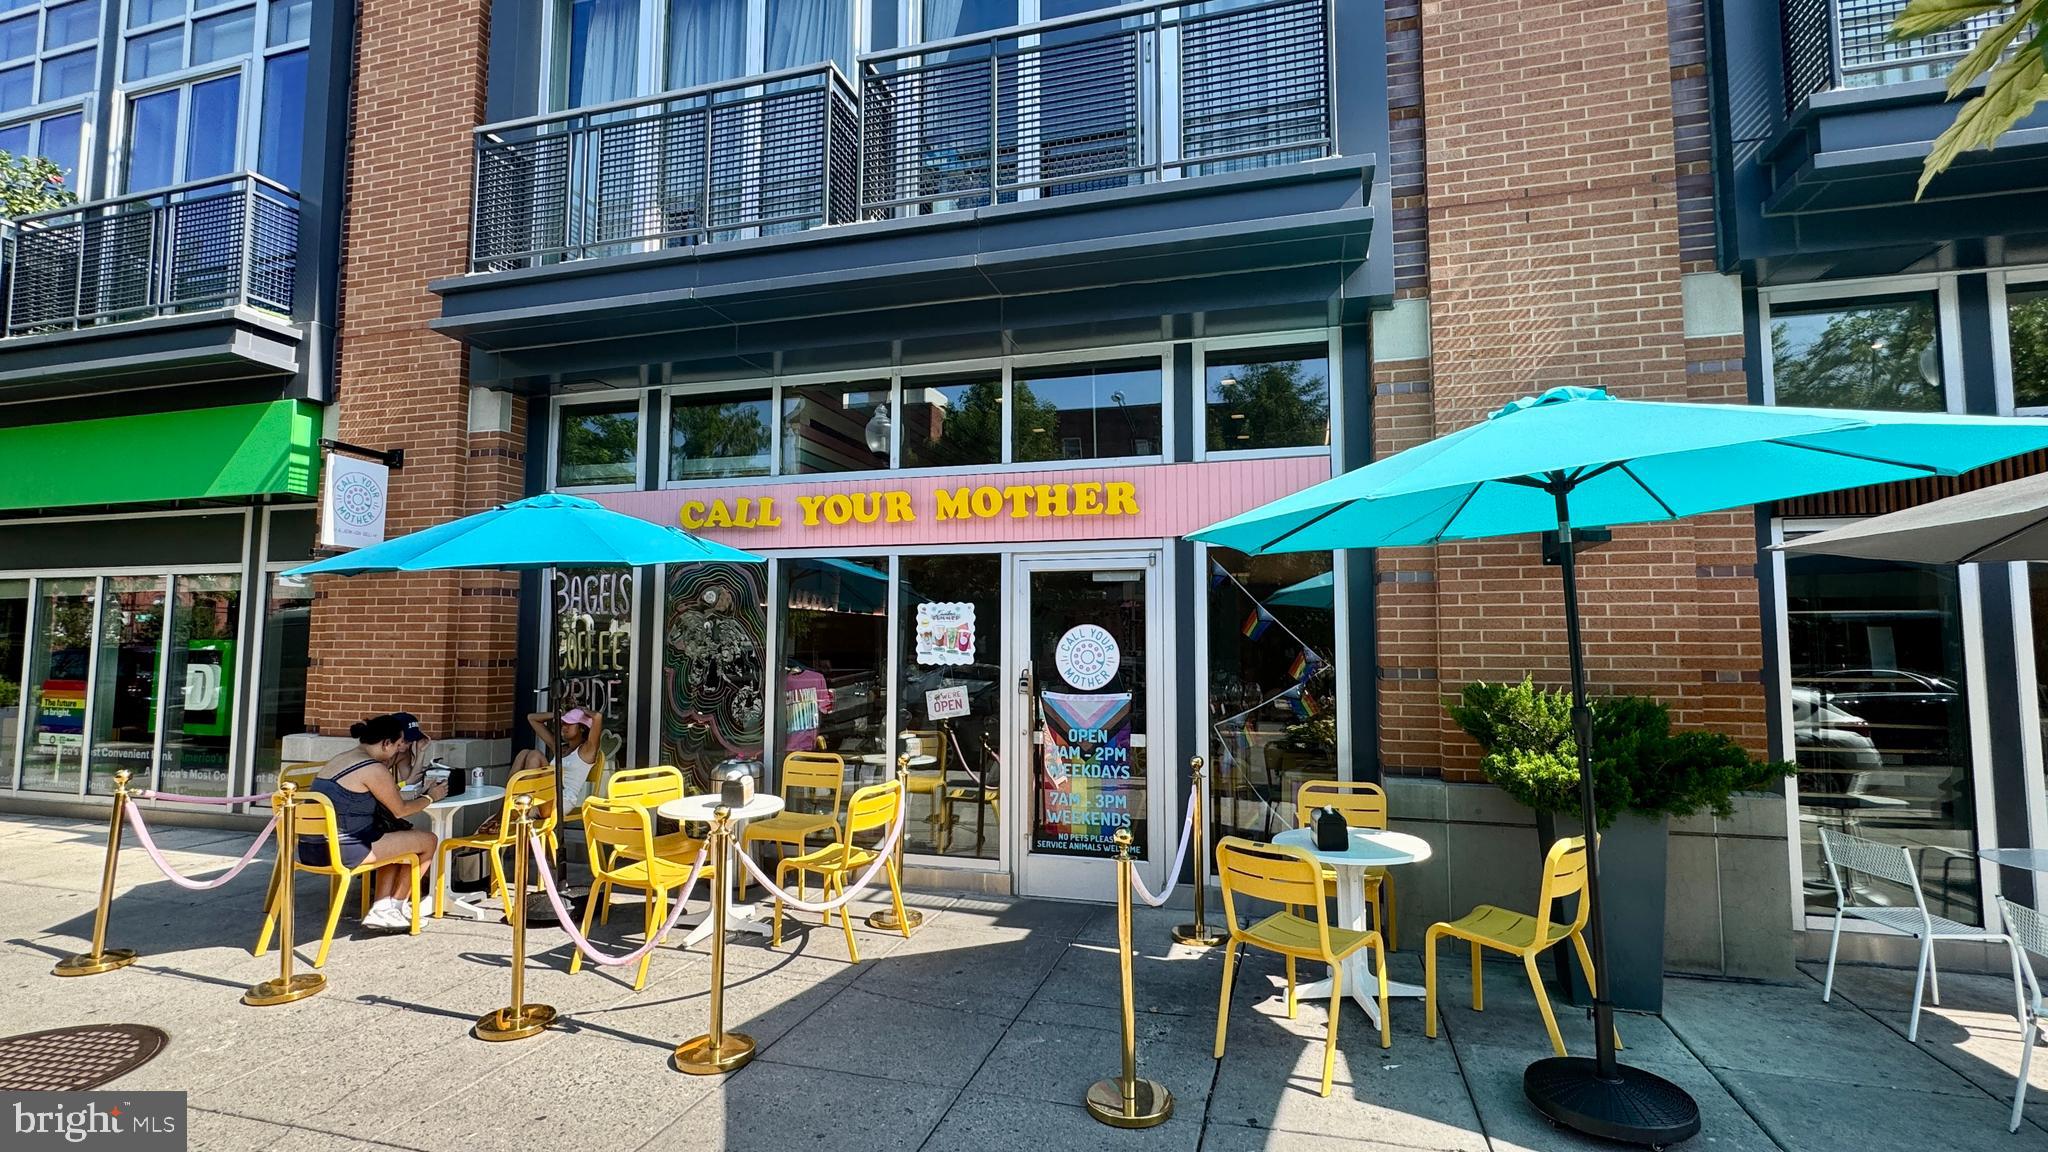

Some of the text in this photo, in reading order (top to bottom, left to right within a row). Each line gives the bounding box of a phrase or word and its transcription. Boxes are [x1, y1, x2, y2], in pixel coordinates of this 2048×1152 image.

[336, 475, 380, 498] CALL YOUR
[679, 481, 1140, 530] CALL YOUR MOTHER
[337, 505, 375, 524] MOTHER
[556, 571, 632, 616] BAGELS
[1061, 628, 1114, 652] CALL YOUR
[558, 629, 628, 671] COFFEE
[1063, 667, 1110, 688] MOTHER
[44, 698, 77, 708] The future
[934, 698, 963, 713] OPEN
[43, 708, 71, 718] is bright.
[1068, 728, 1108, 743] OPEN
[39, 745, 79, 756] Ameca's
[101, 748, 149, 759] Convenient
[1095, 747, 1127, 762] 2PM
[144, 766, 188, 778] Arica's
[189, 769, 211, 780] Most
[1049, 763, 1130, 779] WEEKDAYS
[1050, 792, 1080, 806] 7AM
[1095, 795, 1127, 809] 3PM
[1047, 809, 1131, 828] WEEKENDS
[1058, 833, 1115, 843] NO PETS PLEAS
[1037, 840, 1141, 854] SERVICE ANIMALS WELOME
